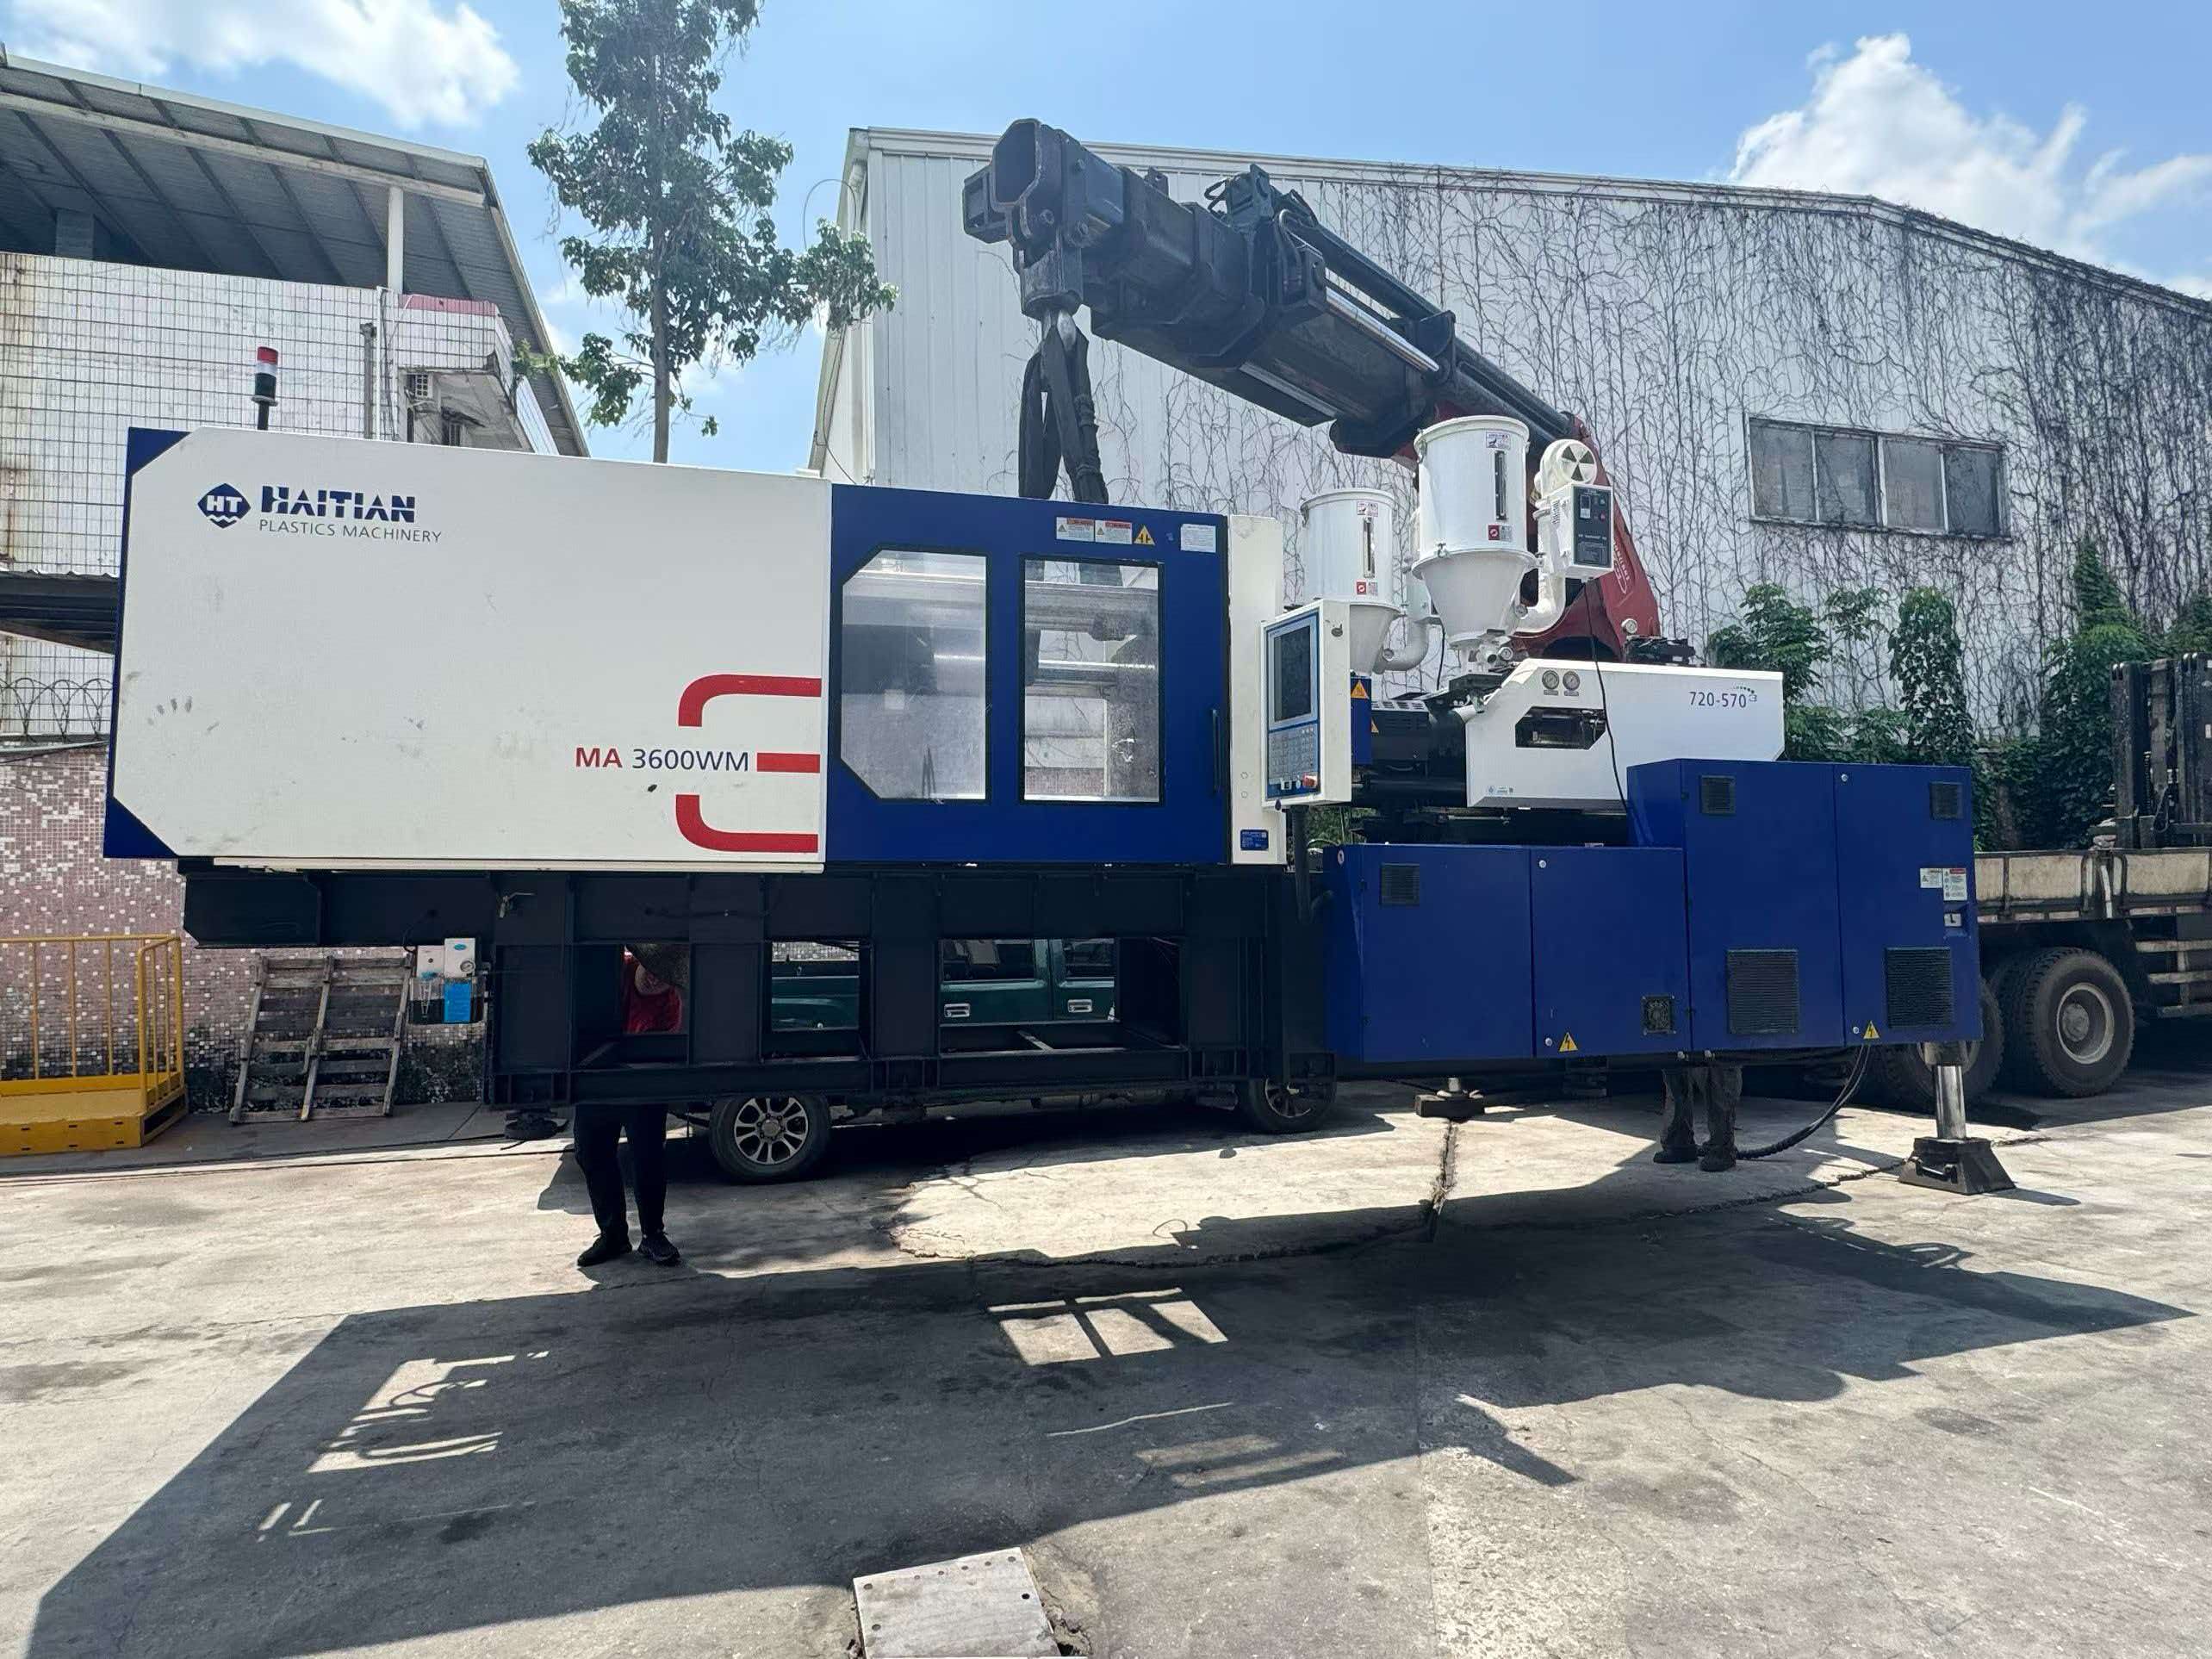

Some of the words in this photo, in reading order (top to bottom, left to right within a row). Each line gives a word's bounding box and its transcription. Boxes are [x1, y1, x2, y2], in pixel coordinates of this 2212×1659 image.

[260, 485, 416, 523] HAITIAN
[259, 519, 335, 536] PLASTICS
[342, 524, 442, 544] MACHINERY
[1689, 691, 1747, 708] 720-570
[575, 747, 623, 768] MA
[631, 748, 749, 772] 3600WM
